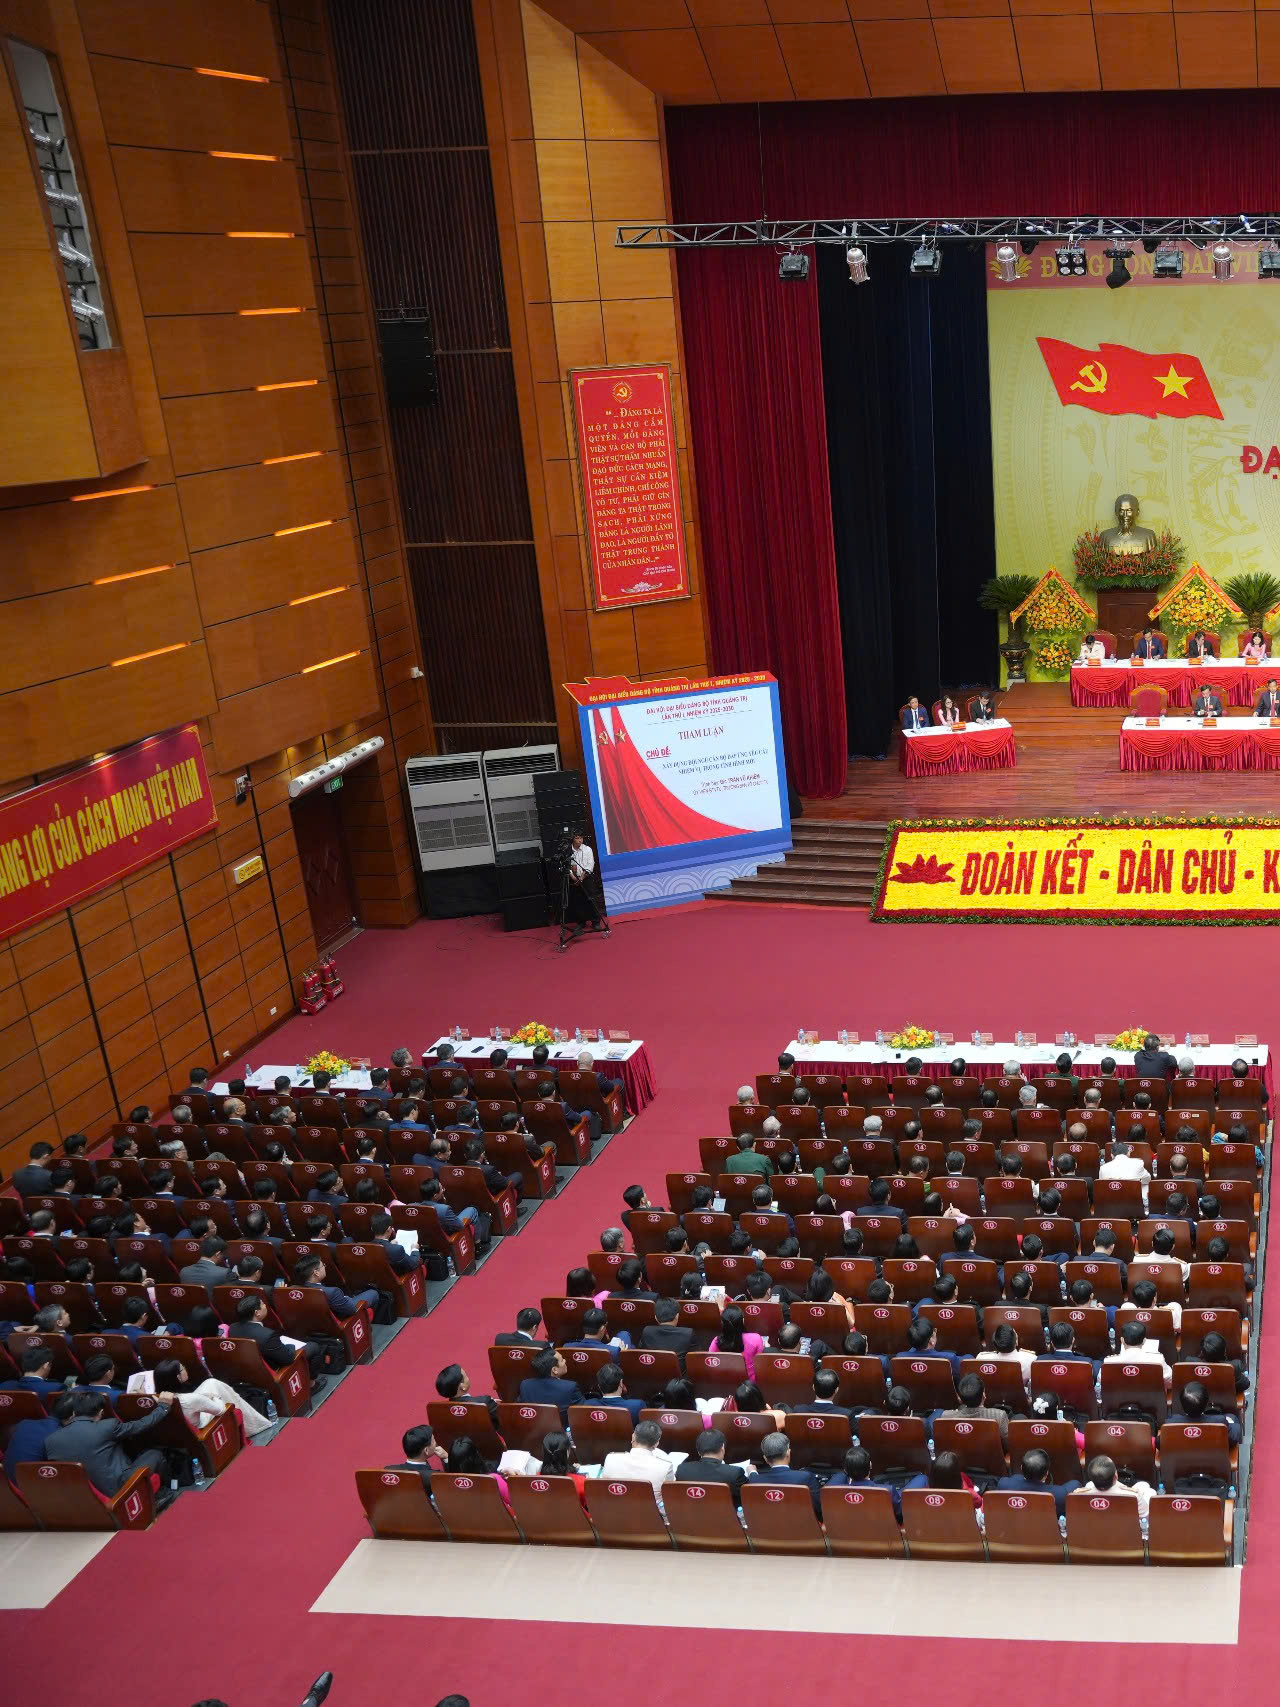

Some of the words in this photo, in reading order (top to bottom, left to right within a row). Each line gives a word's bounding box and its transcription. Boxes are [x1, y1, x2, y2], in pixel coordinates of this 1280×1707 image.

[1040, 255, 1104, 278] ĐG
[678, 729, 701, 740] THAM
[703, 726, 725, 737] LUẬN
[646, 748, 660, 758] CHỦ
[24, 824, 54, 888] LỢI
[48, 802, 83, 870] CỦA
[77, 796, 114, 856] CÁCH
[111, 779, 152, 843] MẠNG
[147, 763, 175, 826] VIỆT
[171, 757, 204, 810] NAM
[960, 841, 1036, 895] ĐOÀN
[1039, 832, 1094, 894] KẾT
[1117, 840, 1173, 894] DÂN
[1182, 831, 1236, 894] CHỦ
[503, 1203, 511, 1215] D
[460, 1241, 468, 1253] E
[411, 1280, 418, 1293] F
[353, 1324, 363, 1337] G
[290, 1376, 300, 1390] H
[385, 1475, 396, 1483] 22
[458, 1480, 468, 1488] 20
[535, 1481, 545, 1490] 18
[612, 1485, 622, 1493] 16
[691, 1489, 701, 1497] 14
[770, 1492, 780, 1500] 12
[849, 1494, 859, 1502] 10
[929, 1496, 940, 1504] 08
[131, 1495, 140, 1515] J
[1011, 1499, 1023, 1507] 06
[1093, 1500, 1105, 1508] 04
[1176, 1501, 1187, 1509] 02
